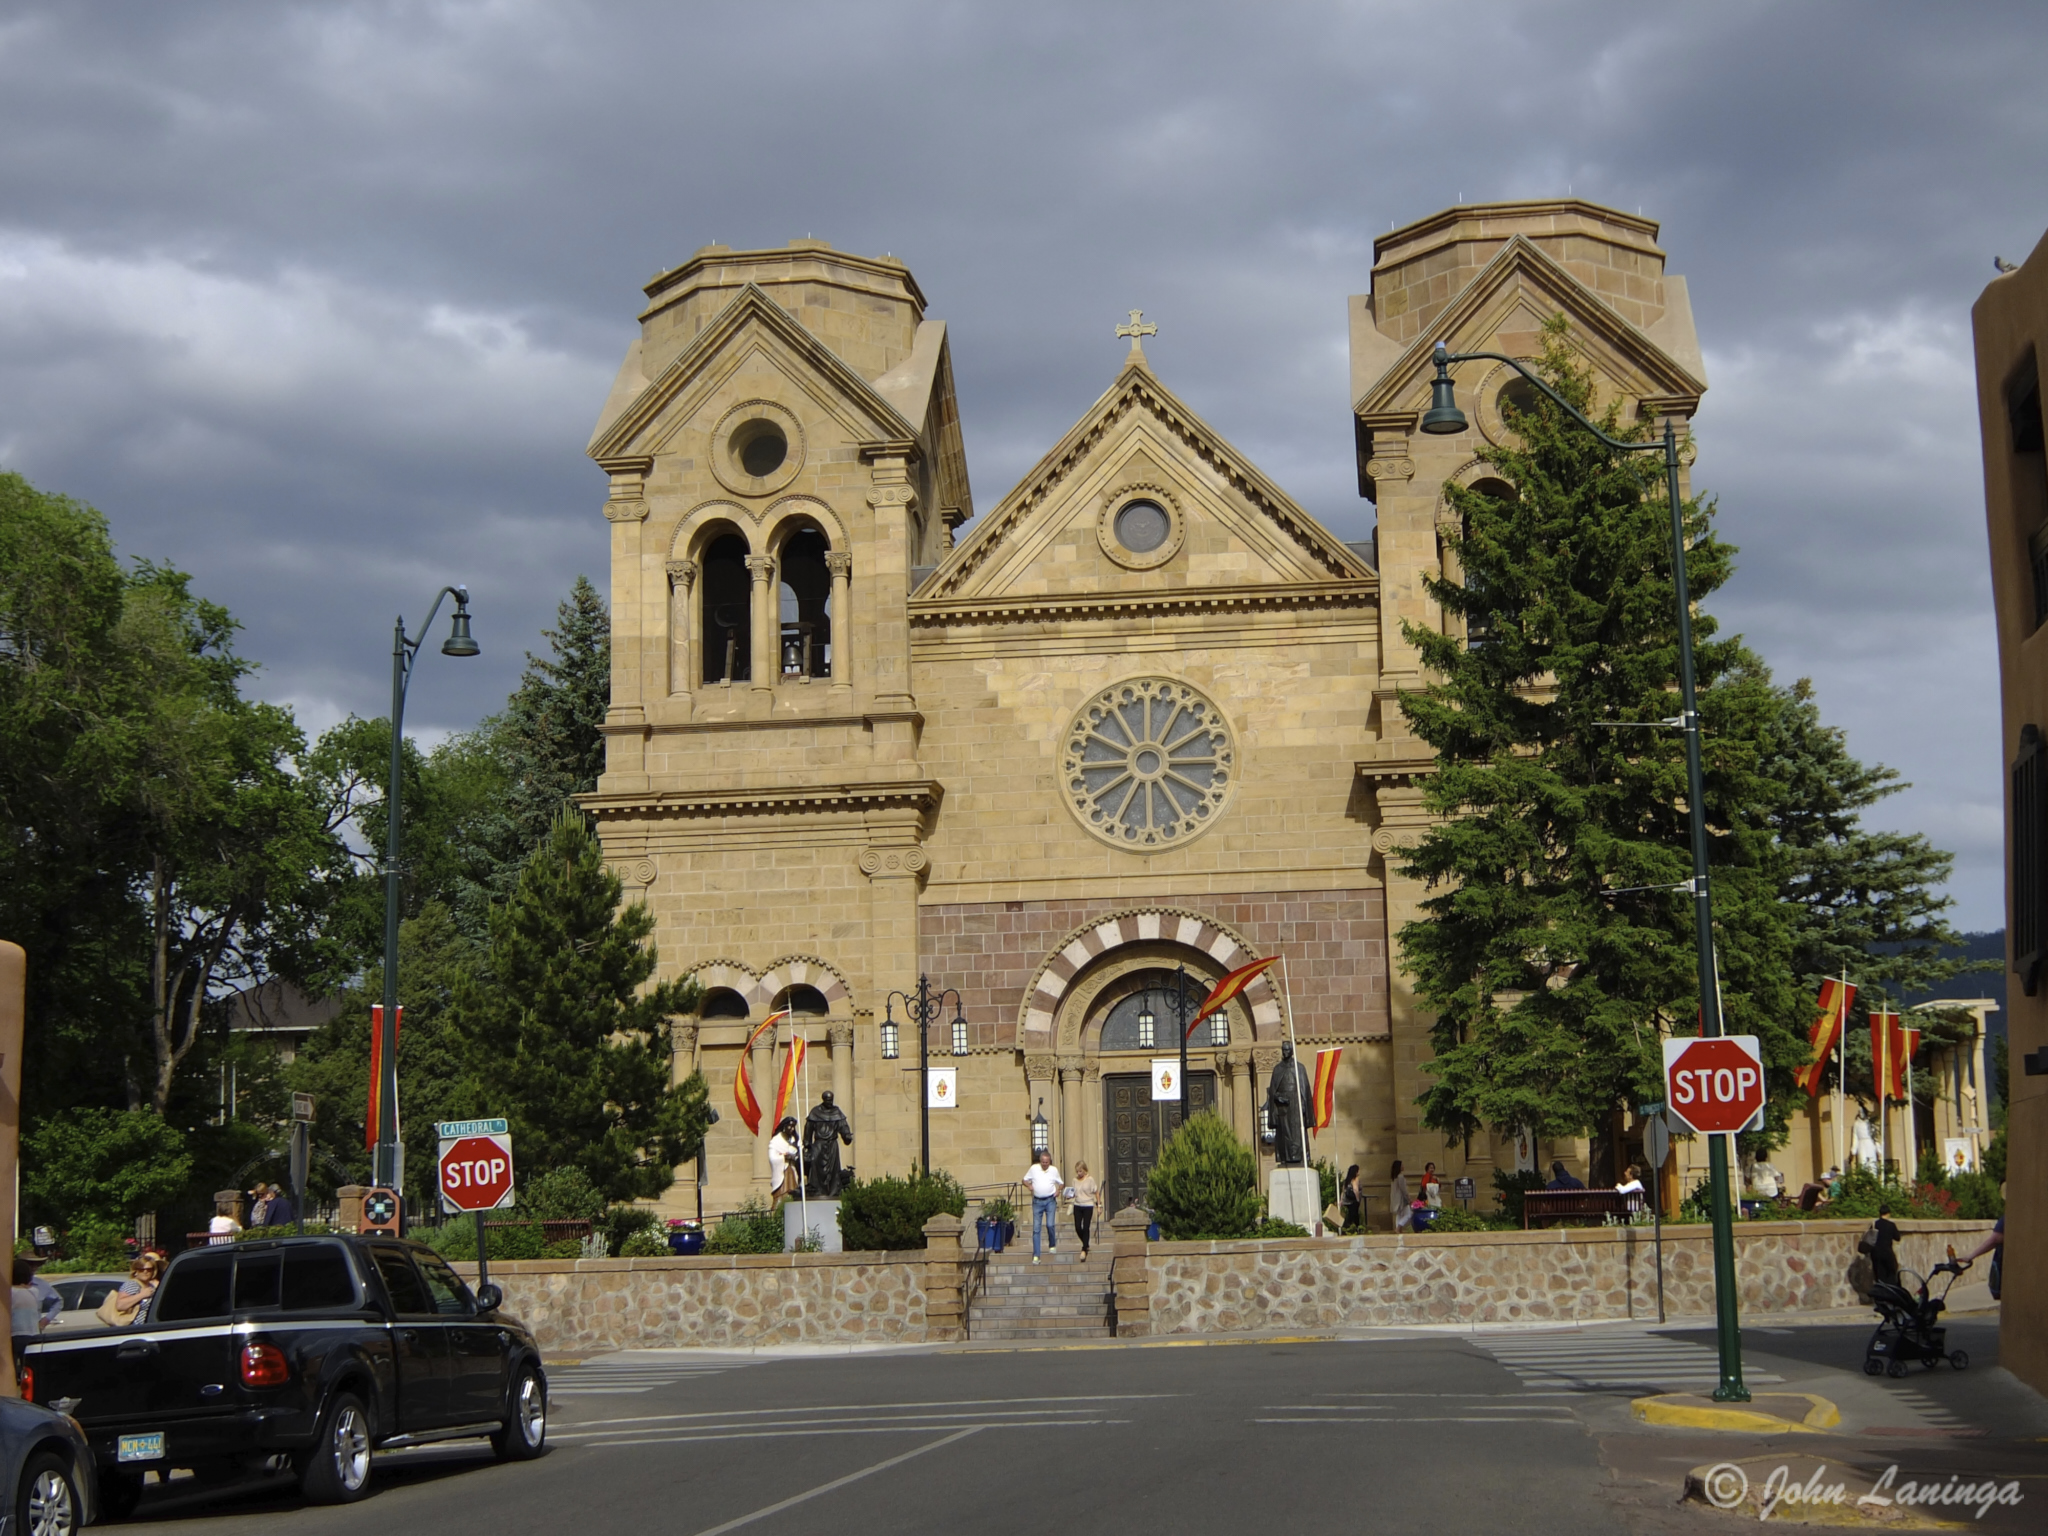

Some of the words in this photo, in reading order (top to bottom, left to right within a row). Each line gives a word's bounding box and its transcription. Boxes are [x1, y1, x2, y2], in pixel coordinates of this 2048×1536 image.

[1675, 1067, 1757, 1104] STOP
[444, 1121, 495, 1136] CATHEDRAL
[446, 1158, 506, 1188] STOP
